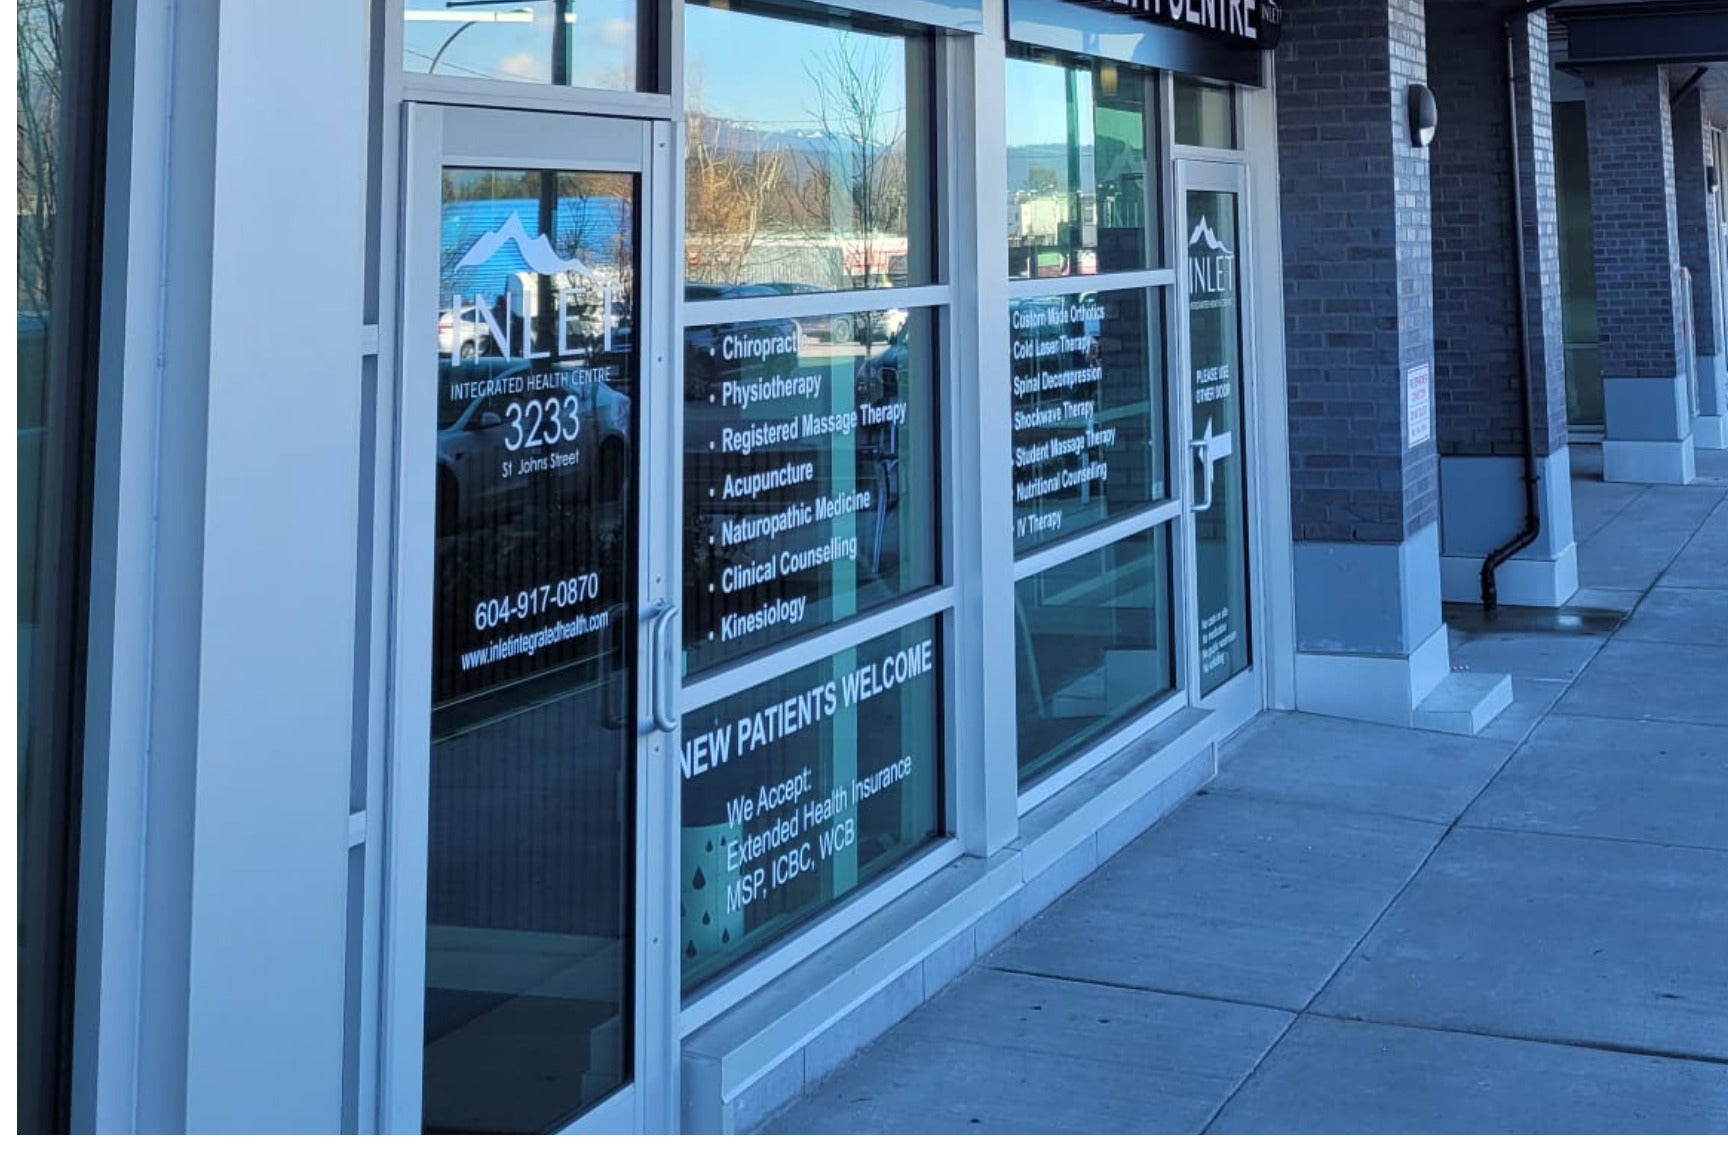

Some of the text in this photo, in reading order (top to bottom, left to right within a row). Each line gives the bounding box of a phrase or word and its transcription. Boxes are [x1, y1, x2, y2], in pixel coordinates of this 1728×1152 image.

[1189, 255, 1234, 294] INLET
[451, 281, 621, 366] INLET
[1013, 310, 1046, 330] Custom
[1070, 304, 1105, 323] Orthotics
[1013, 334, 1092, 360] Cold Laser Therapy
[451, 367, 612, 401] INTEGRATED HEALTH CENTRE
[722, 374, 822, 410] Physiotherapy
[1014, 366, 1102, 399] Spinal Decompression
[504, 395, 580, 451] 3233
[722, 401, 907, 455] Registered Massage Therapy
[1014, 400, 1094, 431] Shockwave Therapy
[502, 449, 579, 478] St Johns Street
[1016, 427, 1116, 468] Student Massage Therapy
[722, 461, 814, 500] Acupuncture
[1016, 461, 1107, 502] Nutritional Counselling
[721, 488, 871, 547] Naturopathic Medicine
[1017, 510, 1062, 538] IV Therapy
[722, 536, 857, 594] Clinical Counselling
[475, 572, 598, 630] 604-917-0870
[721, 596, 806, 642] Kinesiology
[461, 611, 609, 672] www.inletintegratedhealth.com
[680, 640, 932, 779] NEW PATIENTS WELCOME
[727, 767, 813, 828] We Accept:
[728, 755, 912, 872] Extended Health Insurance
[727, 818, 855, 914] MSP, ICBC, WCB
